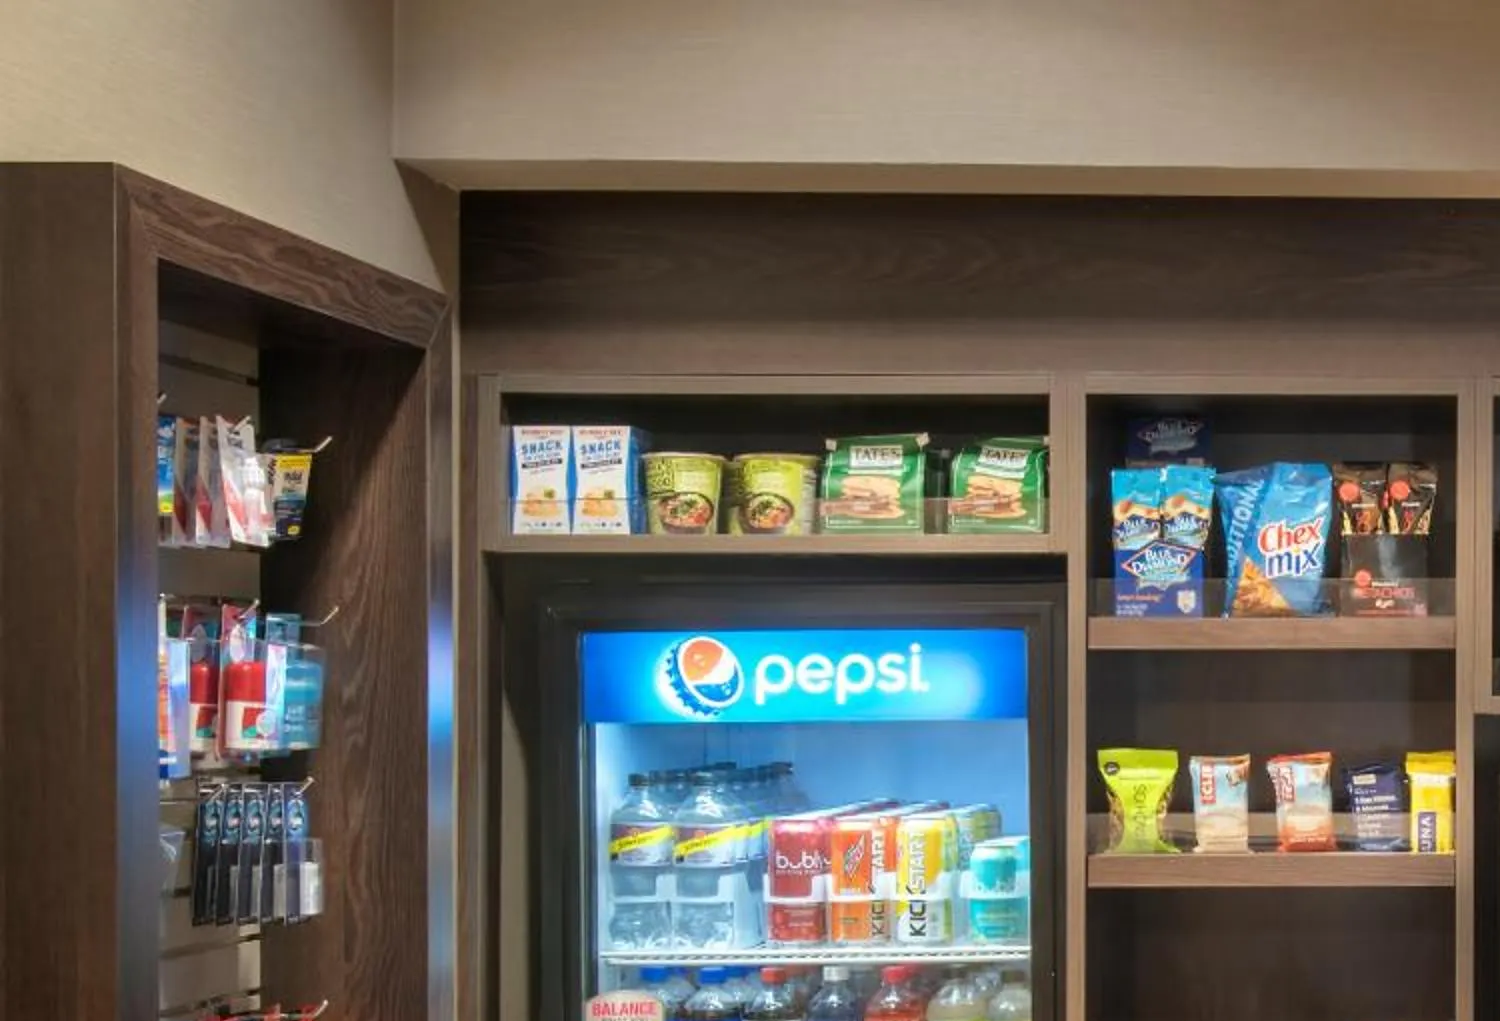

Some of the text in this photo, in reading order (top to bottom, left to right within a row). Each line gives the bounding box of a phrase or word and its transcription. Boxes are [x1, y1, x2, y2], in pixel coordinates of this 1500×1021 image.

[521, 440, 562, 454] SNACK
[581, 440, 621, 454] SNACK
[1258, 518, 1323, 554] Chex
[1267, 541, 1320, 577] mix
[755, 643, 929, 706] pepsi
[591, 1002, 657, 1016] BALANCE
